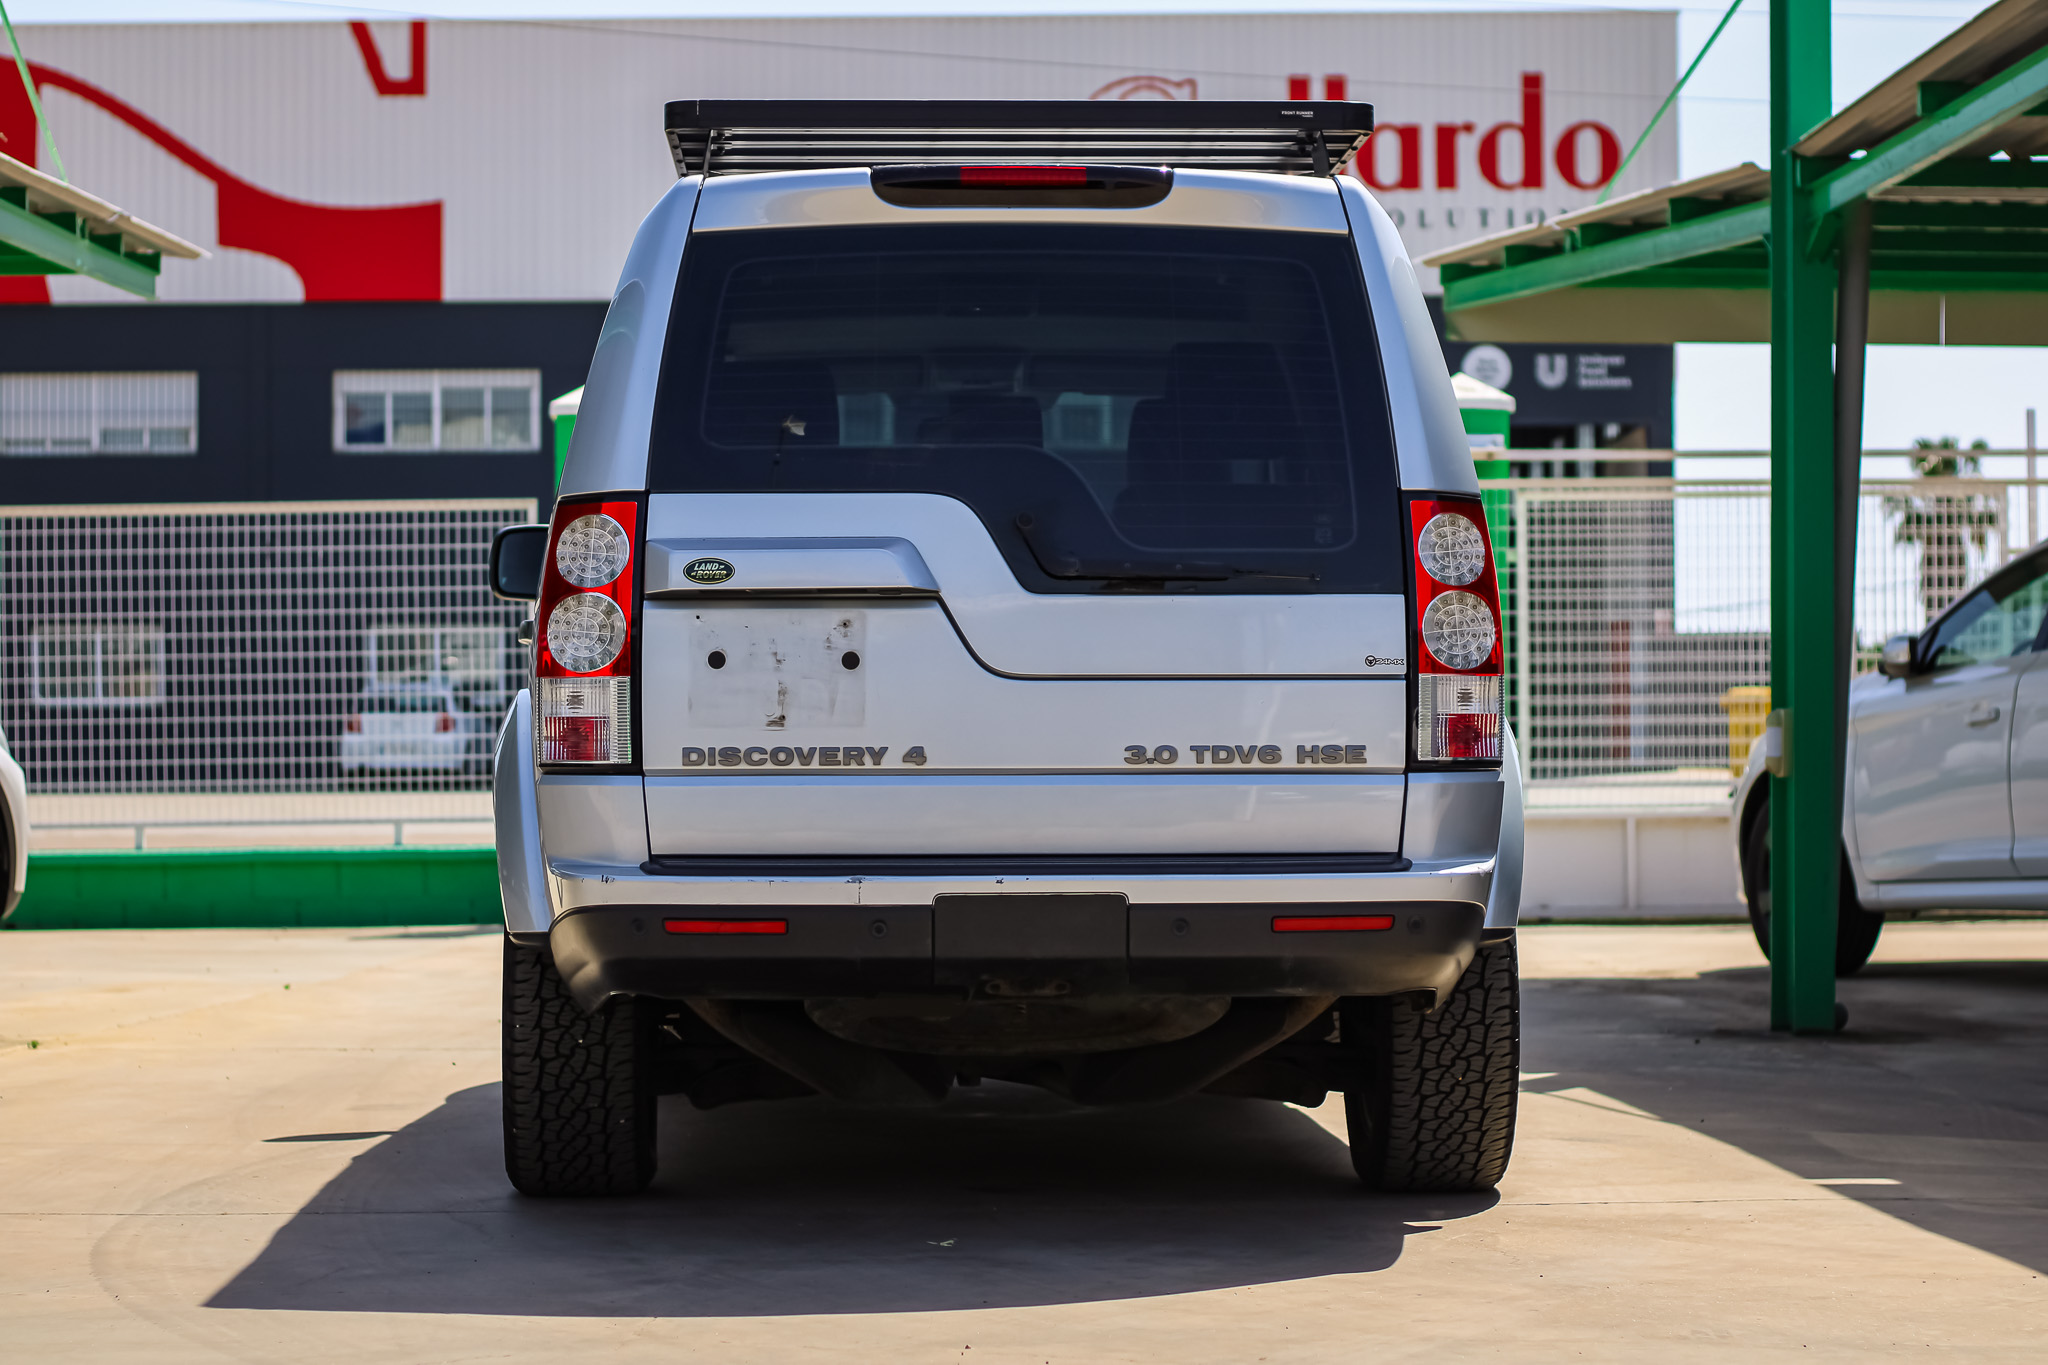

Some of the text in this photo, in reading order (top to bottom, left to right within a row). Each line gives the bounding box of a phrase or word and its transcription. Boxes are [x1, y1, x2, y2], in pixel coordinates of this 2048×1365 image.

[693, 562, 719, 571] LAND
[695, 570, 727, 579] ROVER
[681, 745, 928, 767] DISCOVERY 4
[1123, 744, 1368, 765] 3.0 TDV6 HSE
